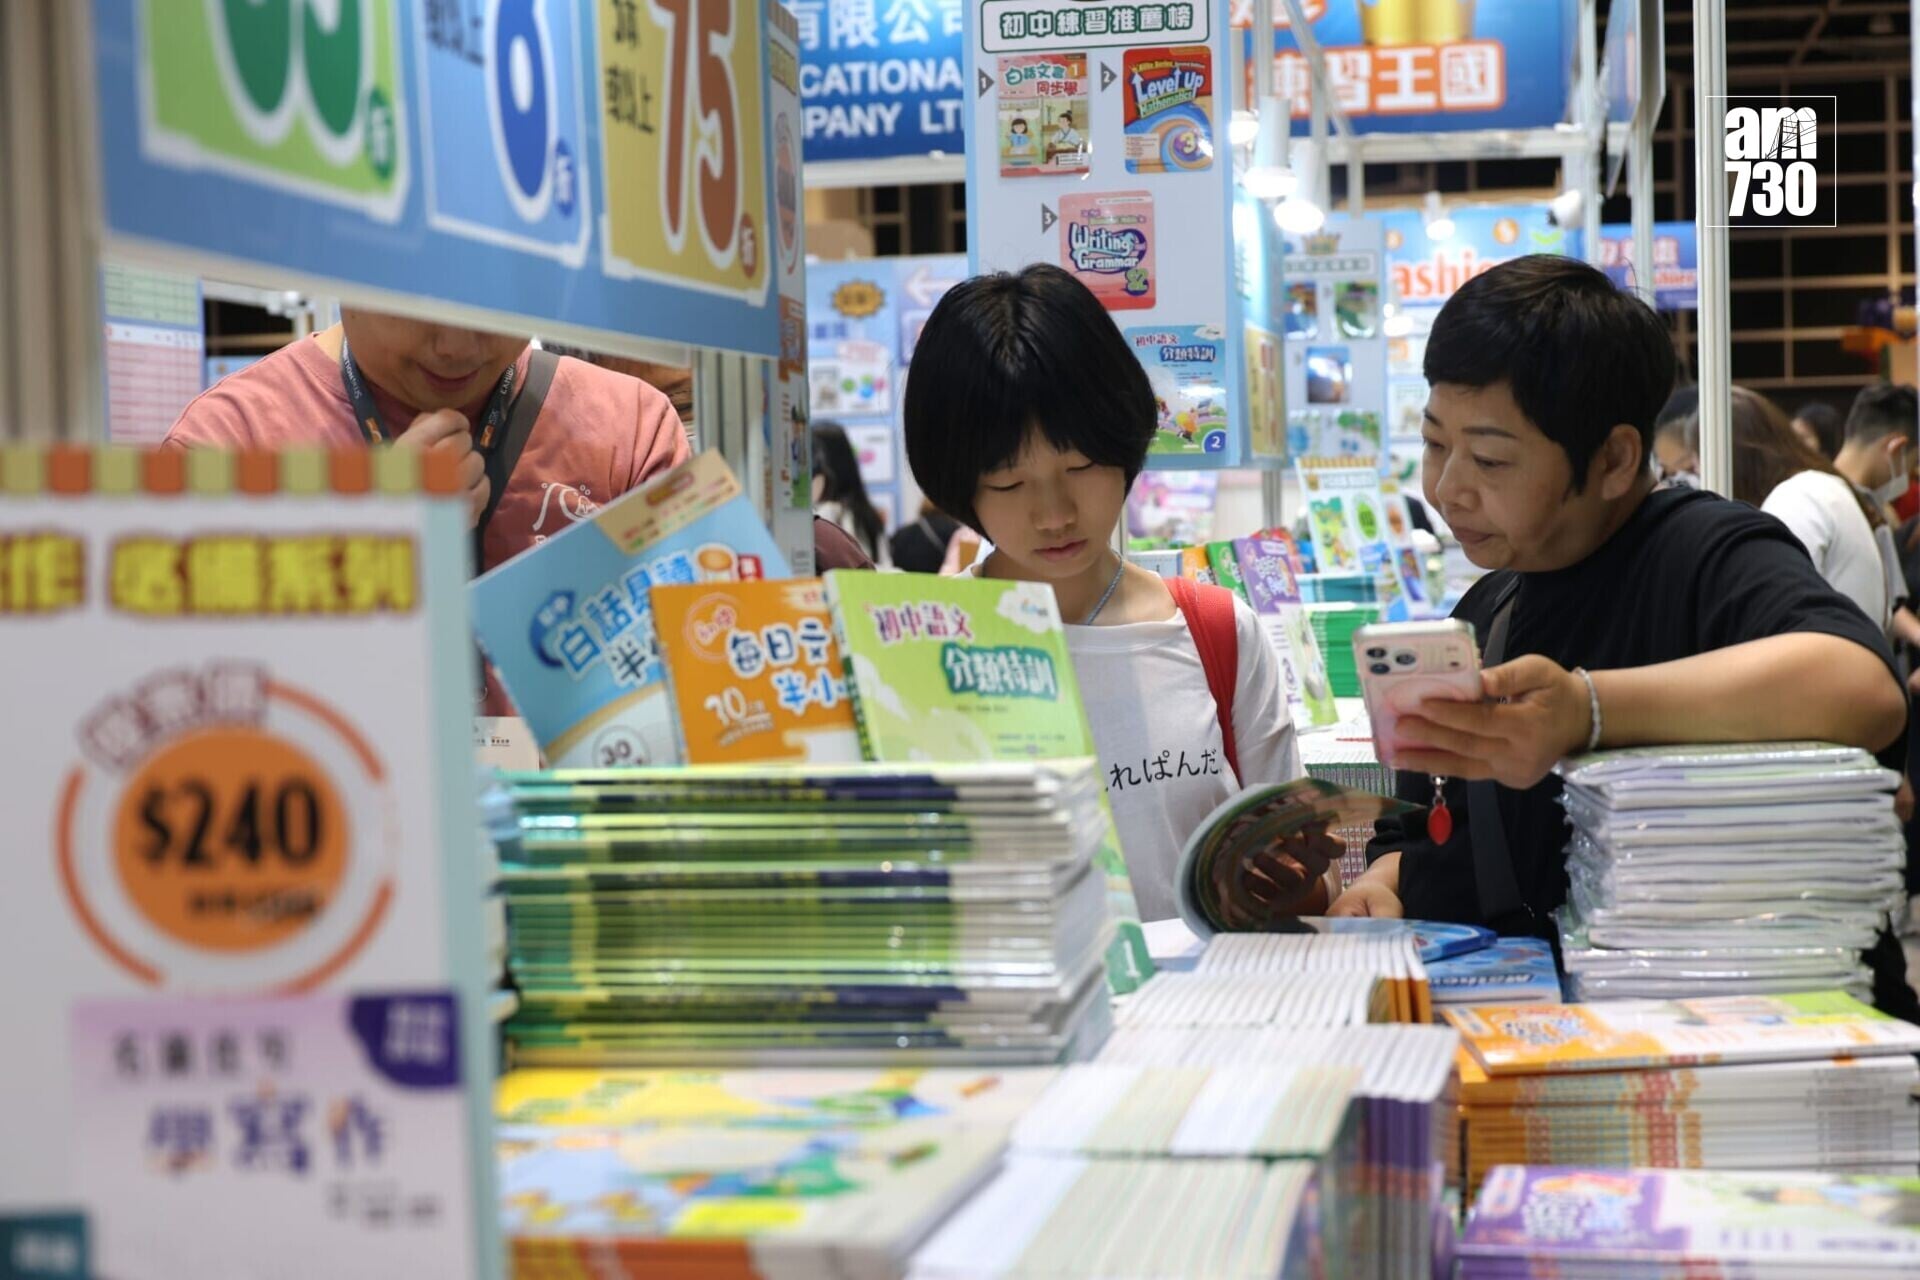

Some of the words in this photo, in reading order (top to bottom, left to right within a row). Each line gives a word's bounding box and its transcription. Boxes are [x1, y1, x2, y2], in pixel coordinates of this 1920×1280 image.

[1001, 4, 1194, 39] 初中練習推薦榜
[800, 57, 963, 98] CATIONA
[1103, 71, 1111, 83] 2
[1131, 67, 1181, 104] Level
[1184, 71, 1204, 99] Up
[800, 101, 902, 140] PANY
[919, 98, 964, 135] LT
[1180, 131, 1198, 154] 3
[1070, 222, 1132, 257] Writing
[1078, 249, 1140, 269] Grammar
[1210, 435, 1221, 449] 2
[873, 603, 973, 643] 初中語文
[944, 646, 1056, 697] 分類特訓
[1105, 748, 1220, 792] れぱんだ
[135, 781, 323, 863] $240
